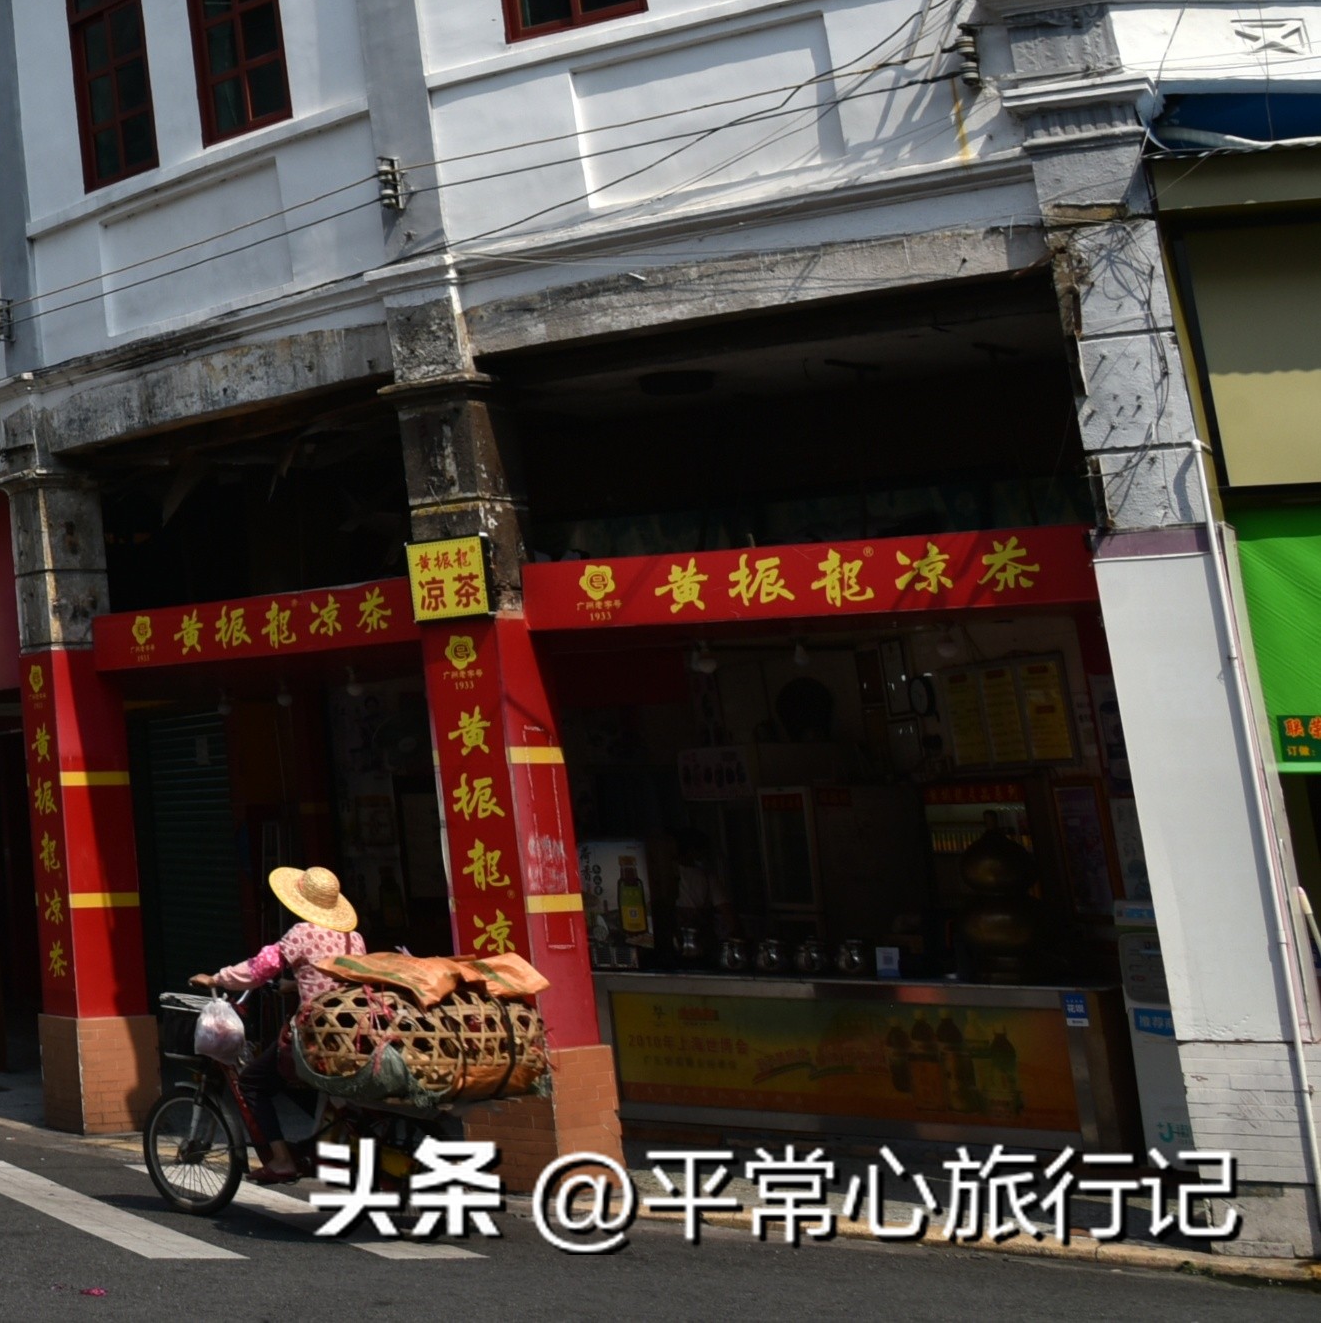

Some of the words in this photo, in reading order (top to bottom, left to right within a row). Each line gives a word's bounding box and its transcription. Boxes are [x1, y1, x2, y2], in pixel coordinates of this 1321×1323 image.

[418, 572, 481, 612] 凉茶
[589, 611, 613, 622] 1933
[455, 681, 475, 691] 1933
